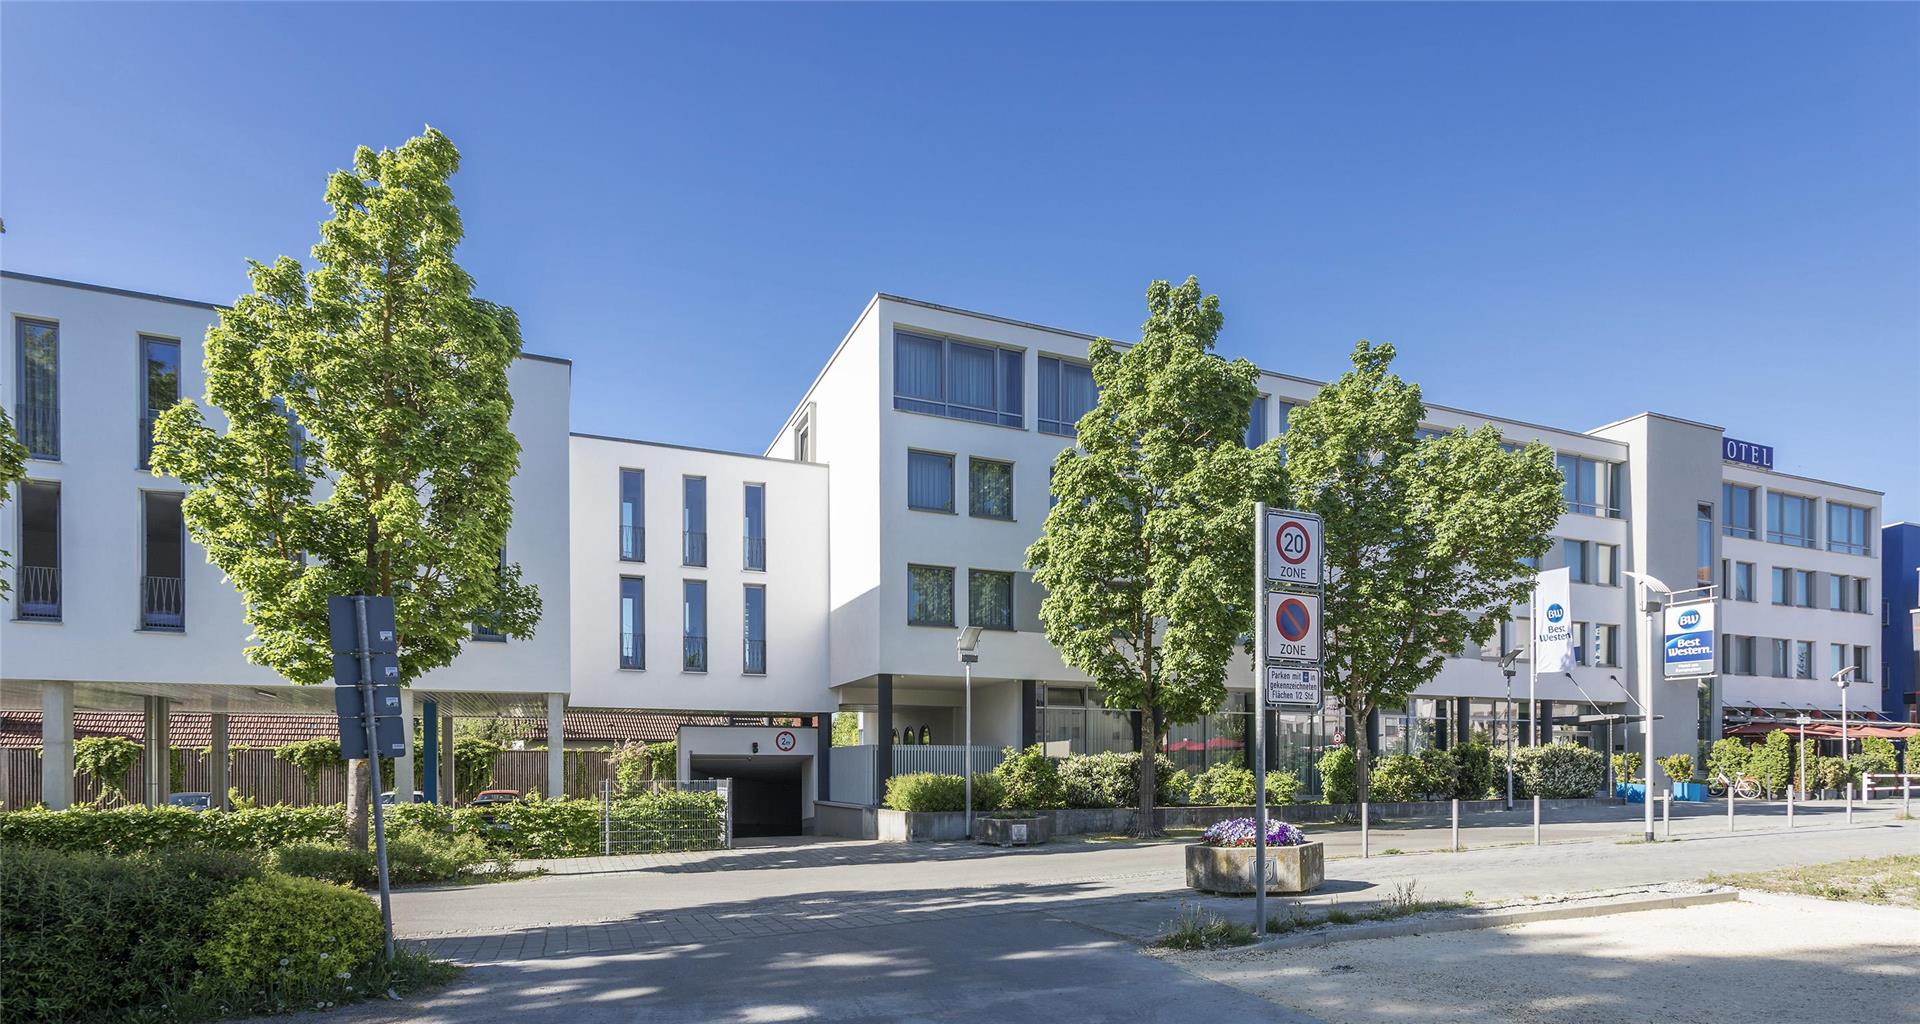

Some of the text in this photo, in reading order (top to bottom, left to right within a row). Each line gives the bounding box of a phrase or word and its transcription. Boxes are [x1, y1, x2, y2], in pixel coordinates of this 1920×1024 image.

[1727, 441, 1771, 466] OTEL
[1284, 532, 1304, 553] 20
[1280, 566, 1306, 579] ZONE
[1548, 609, 1563, 619] BW
[1680, 614, 1699, 626] BW
[1548, 625, 1566, 634] Best
[1539, 632, 1571, 642] Westen
[1677, 638, 1701, 648] Best
[1280, 644, 1306, 656] ZONE
[1271, 670, 1316, 681] Parken mit in
[1270, 681, 1317, 691] gekennzeichneten
[1272, 690, 1293, 699] Flächen
